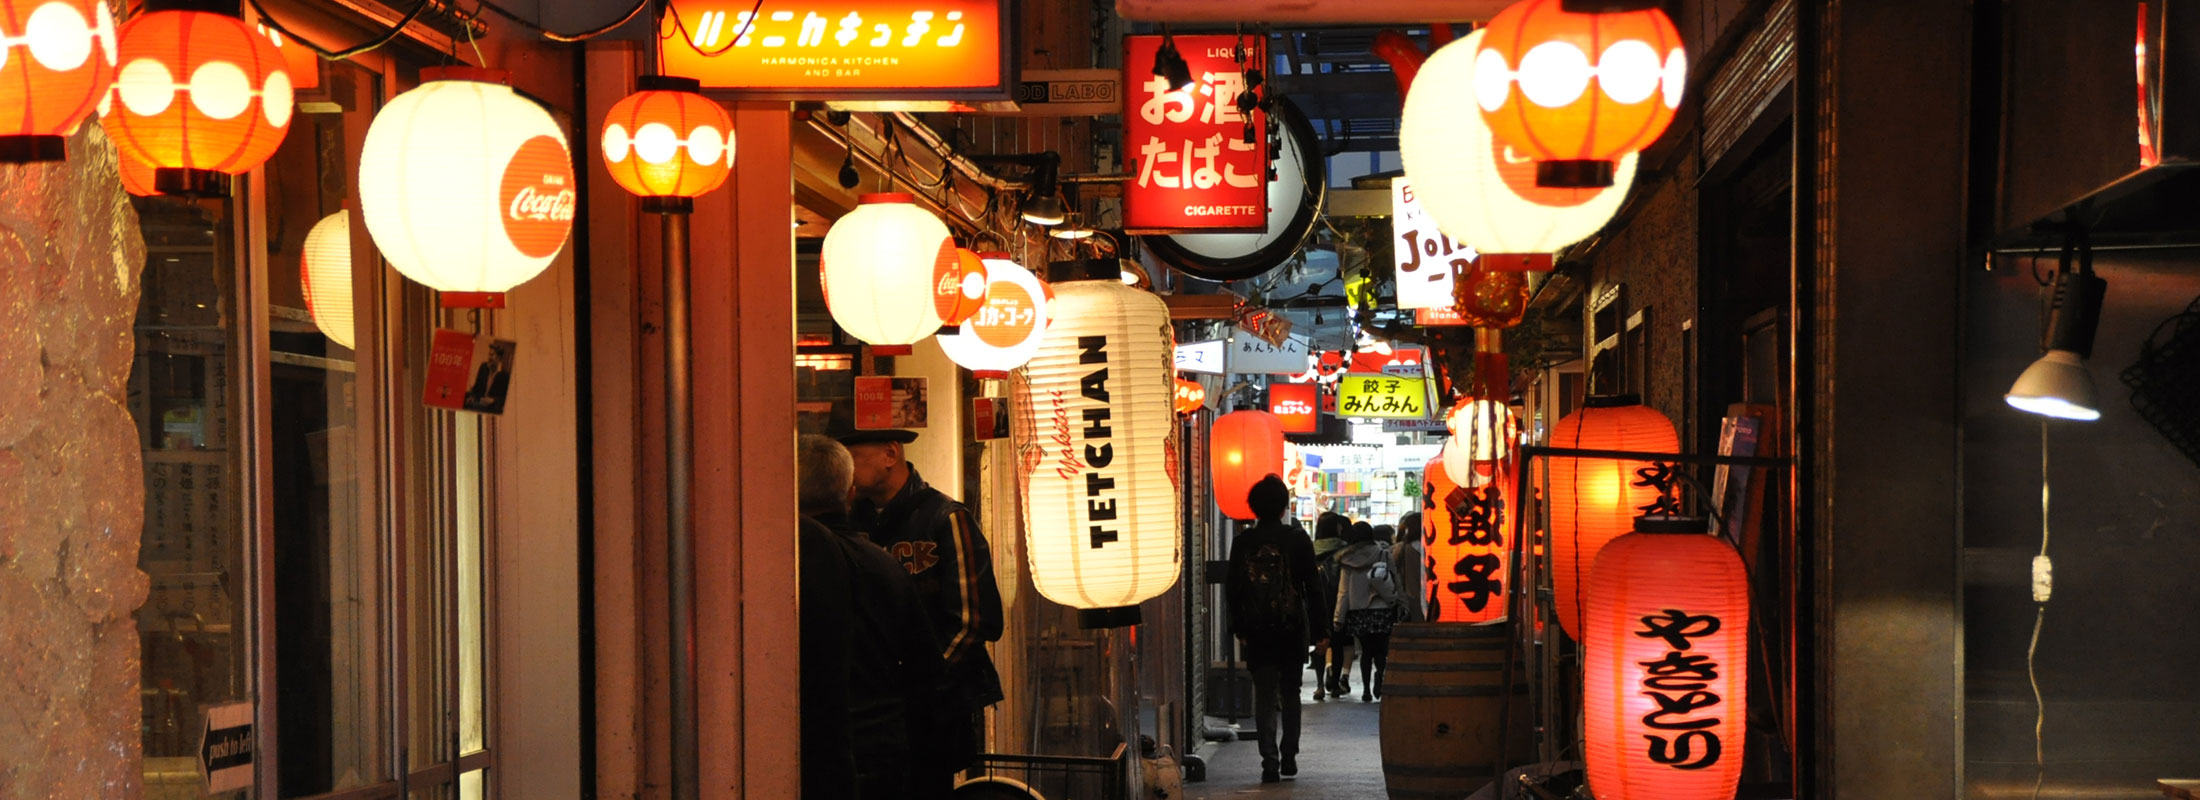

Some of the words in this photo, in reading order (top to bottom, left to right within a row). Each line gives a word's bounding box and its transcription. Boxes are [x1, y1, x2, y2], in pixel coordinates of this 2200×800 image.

[761, 57, 838, 66] HARMONICA
[843, 57, 899, 66] KITCHEN
[804, 69, 830, 77] AND
[836, 69, 861, 77] BAR
[1051, 83, 1112, 100] LABO
[1140, 71, 1256, 126] お酒
[1137, 132, 1259, 190] たばこ
[1184, 205, 1257, 217] CIGARETTE
[1363, 379, 1401, 394] 餃子
[1344, 395, 1418, 413] みんみん
[1077, 334, 1119, 550] TETCHAN
[1634, 608, 1722, 770] やきとり
[208, 735, 229, 767] push
[230, 738, 239, 756] to
[240, 731, 252, 754] left
